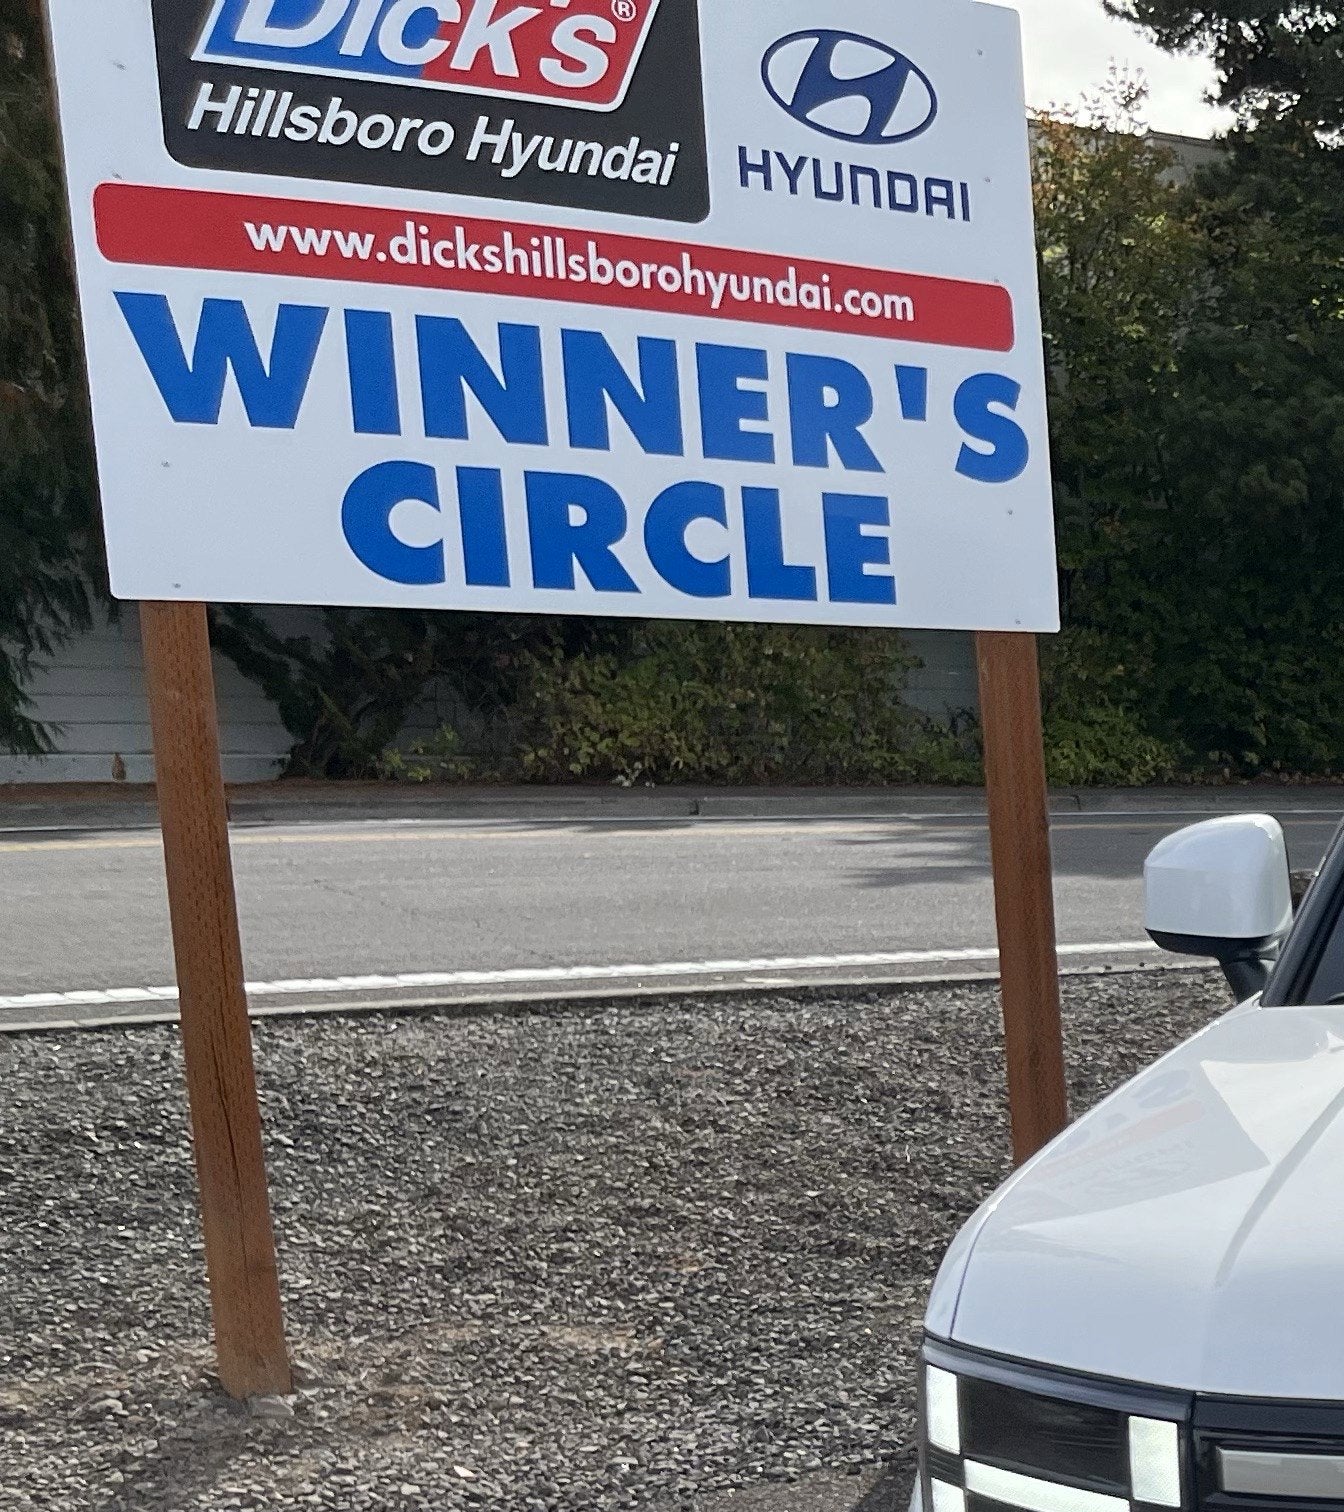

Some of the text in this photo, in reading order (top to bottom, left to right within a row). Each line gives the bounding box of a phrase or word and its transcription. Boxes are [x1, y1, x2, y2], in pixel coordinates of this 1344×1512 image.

[187, 82, 681, 187] Hillsboro Hyundai
[737, 145, 970, 222] HYUNDAI
[243, 221, 915, 322] www.dickshillsborohyundai.com
[112, 291, 1029, 482] WINNER'S
[341, 460, 897, 605] CIRCLE
